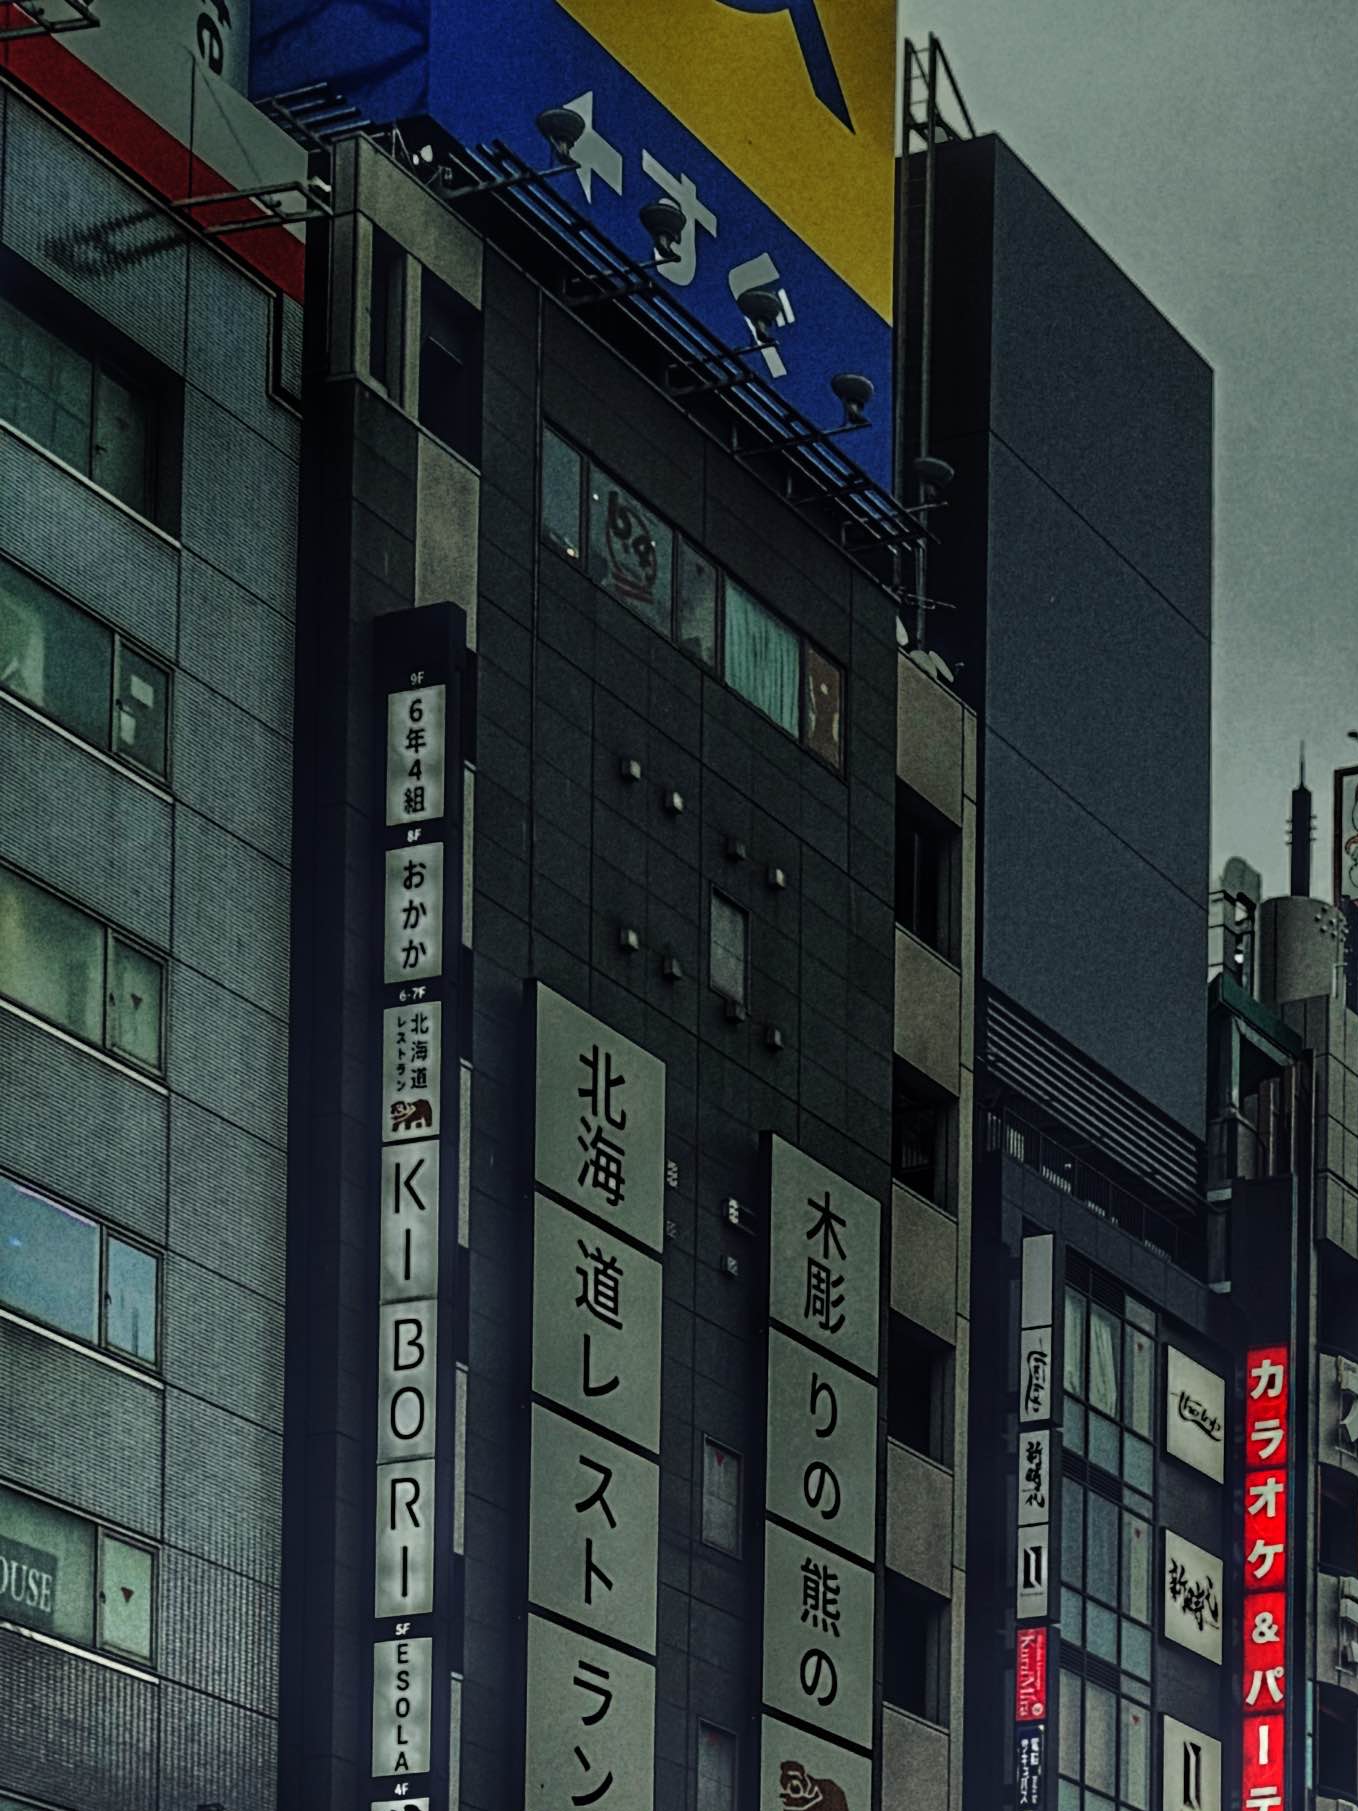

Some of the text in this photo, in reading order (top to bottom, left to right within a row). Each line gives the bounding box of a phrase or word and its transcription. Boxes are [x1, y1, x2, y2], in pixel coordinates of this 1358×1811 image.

[406, 698, 425, 815] 6年4組
[401, 861, 427, 969] おかか
[409, 1012, 431, 1089] 北海道
[389, 1158, 426, 1600] KIBORI
[571, 1044, 629, 1809] 北海道レストラン
[799, 1189, 848, 1709] 木彫りの熊の
[393, 1642, 411, 1773] ESOLA
